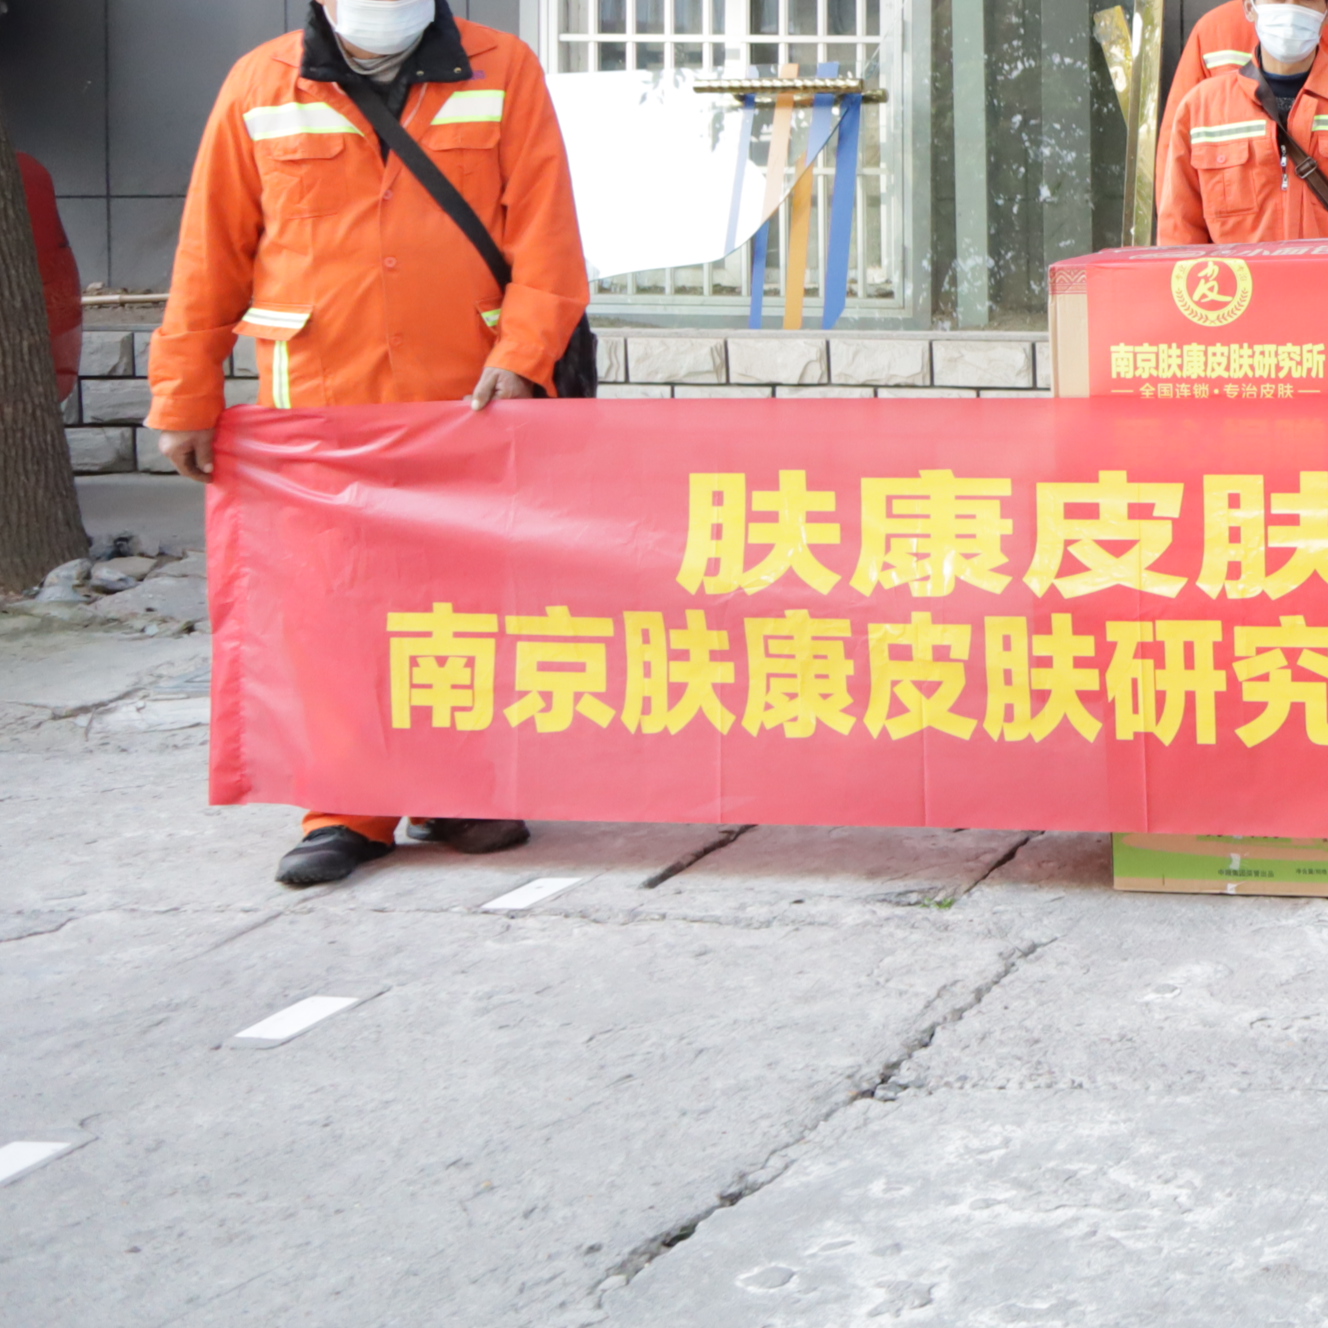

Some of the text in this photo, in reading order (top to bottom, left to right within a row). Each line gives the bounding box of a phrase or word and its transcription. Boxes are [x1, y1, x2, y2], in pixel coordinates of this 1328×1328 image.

[1110, 342, 1326, 379] 南京肤康皮肤研究所
[1138, 382, 1295, 399] 全国连锁·专治皮肤
